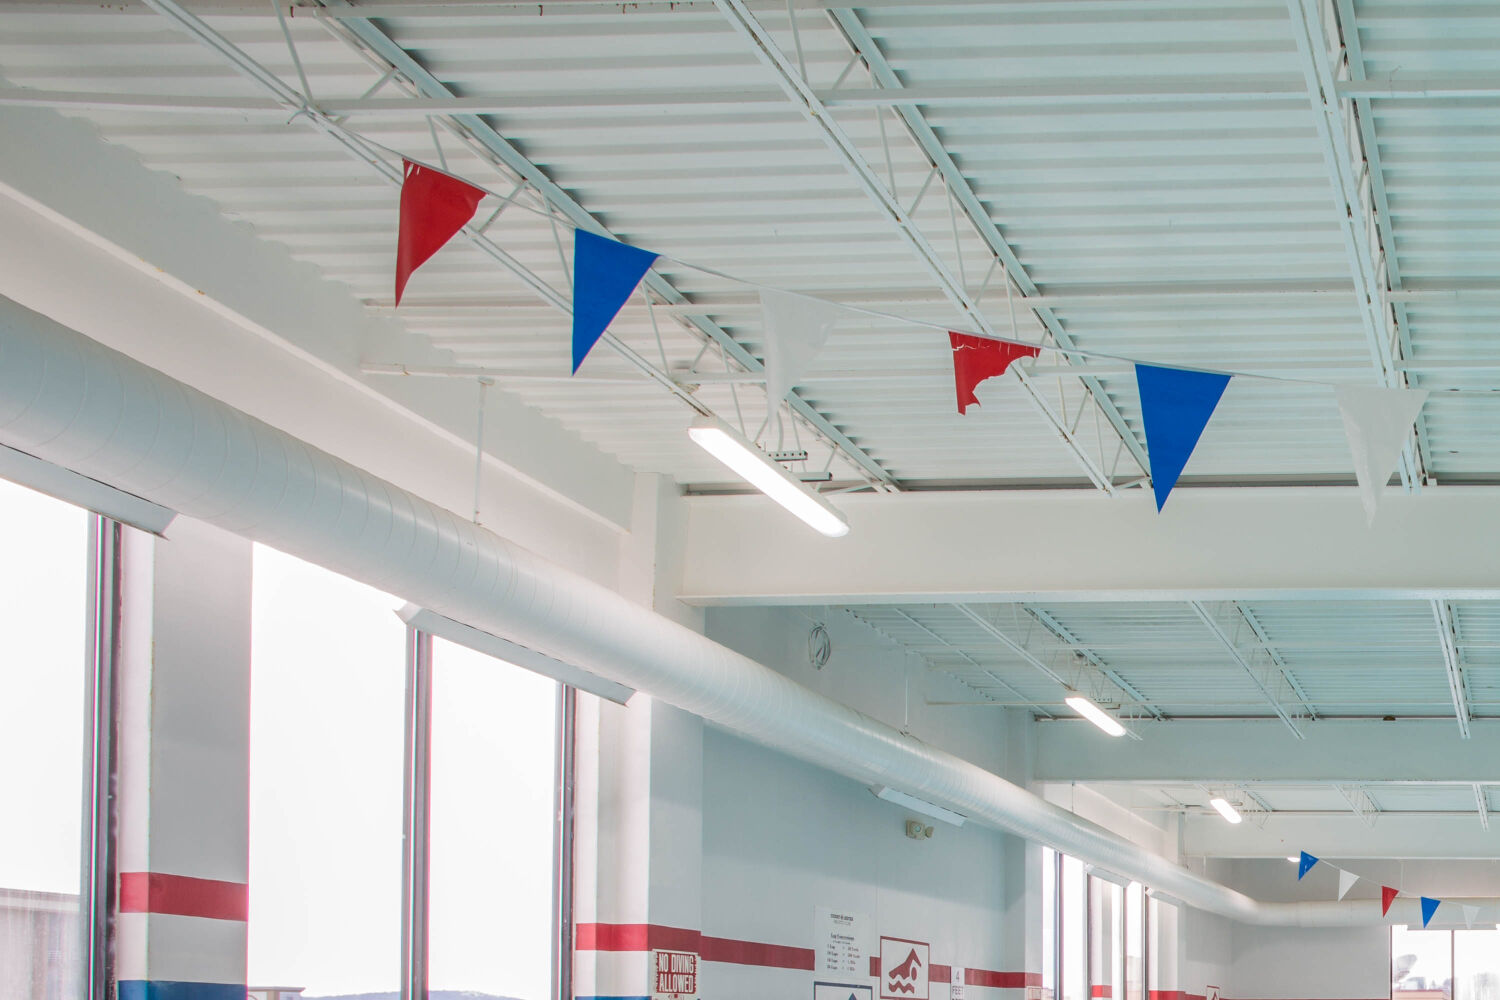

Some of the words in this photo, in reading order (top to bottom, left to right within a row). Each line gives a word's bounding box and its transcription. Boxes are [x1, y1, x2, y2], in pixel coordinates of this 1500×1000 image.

[659, 953, 669, 972] NO
[671, 954, 694, 974] DIVING
[659, 973, 694, 993] ALLOWED
